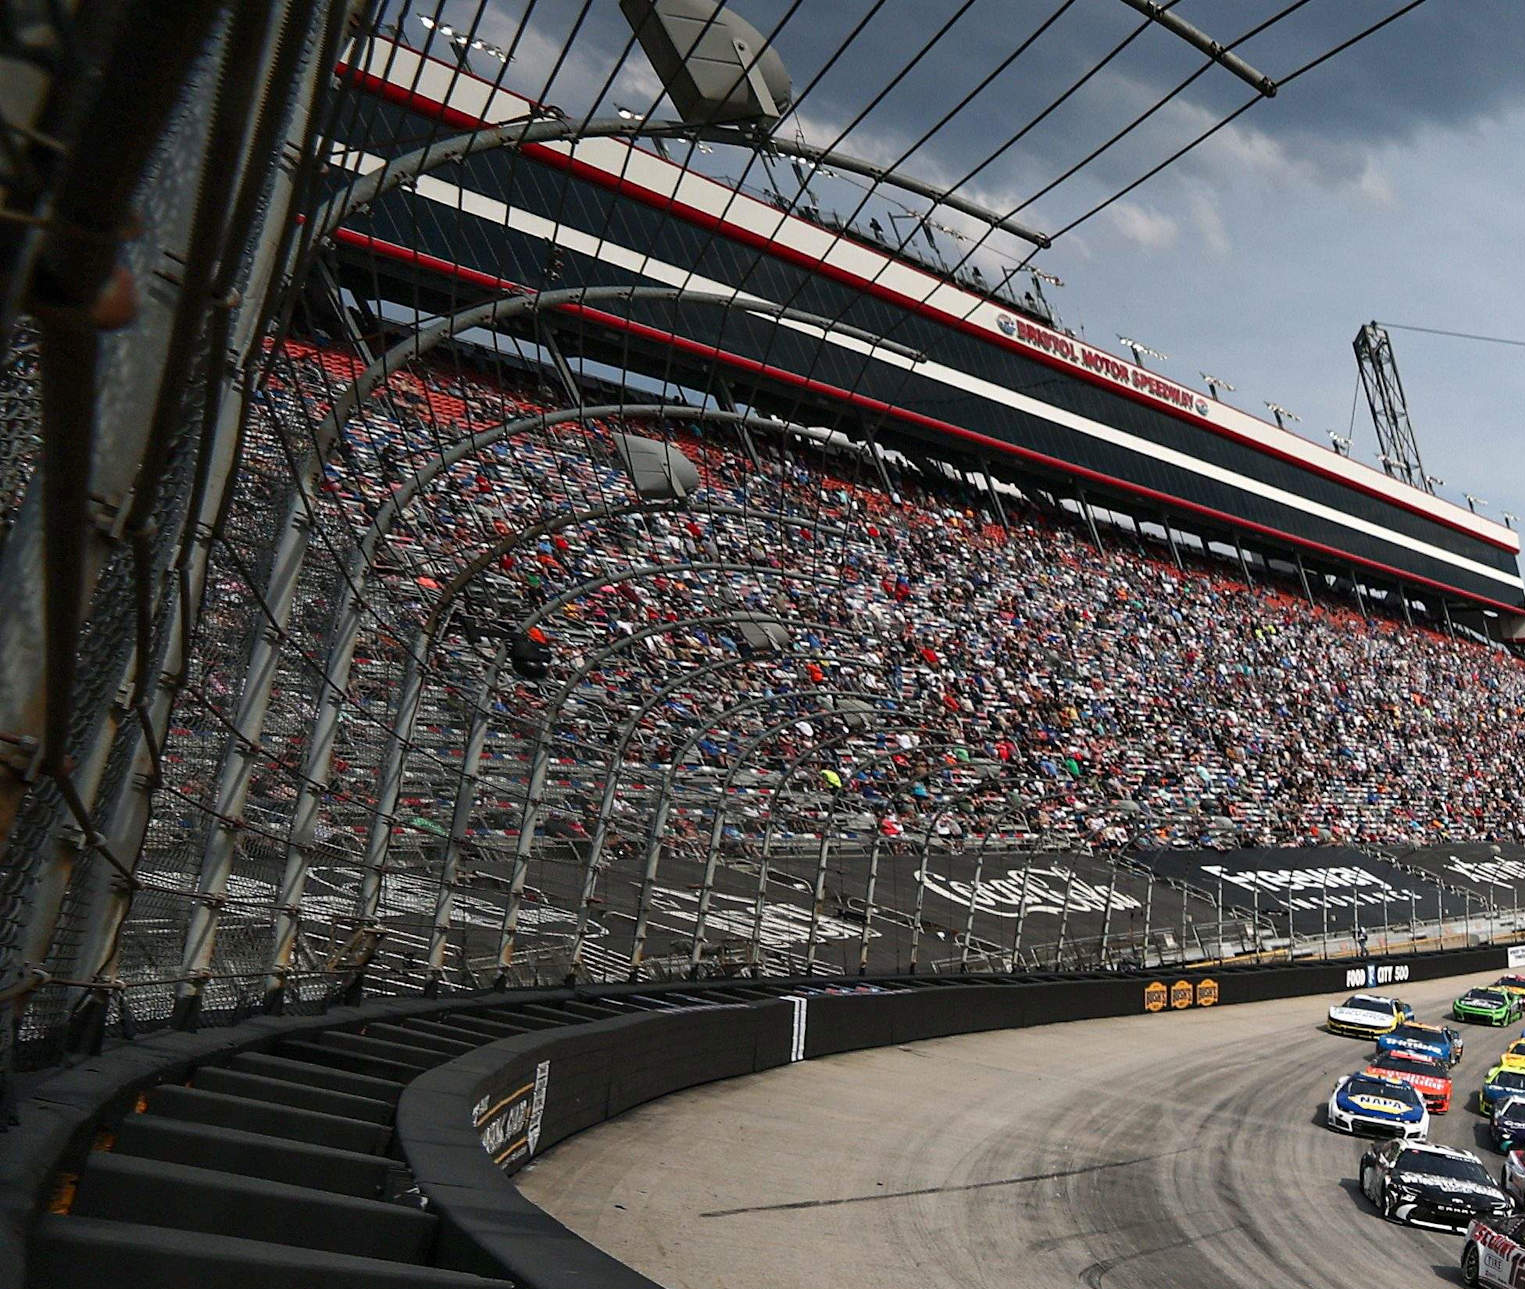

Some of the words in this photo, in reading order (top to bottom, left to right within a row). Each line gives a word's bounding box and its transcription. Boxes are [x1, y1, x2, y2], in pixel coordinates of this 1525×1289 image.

[1016, 319, 1079, 362] BRISTOL
[1081, 348, 1129, 384] MOTOR
[1132, 369, 1194, 411] SPEEDWAY
[1201, 864, 1393, 893] Freeway
[1345, 967, 1366, 987] FOOD
[1377, 965, 1393, 983] CITY
[1394, 964, 1409, 981] 500
[1360, 1096, 1402, 1110] NAPA
[1437, 1205, 1477, 1216] CAMRY
